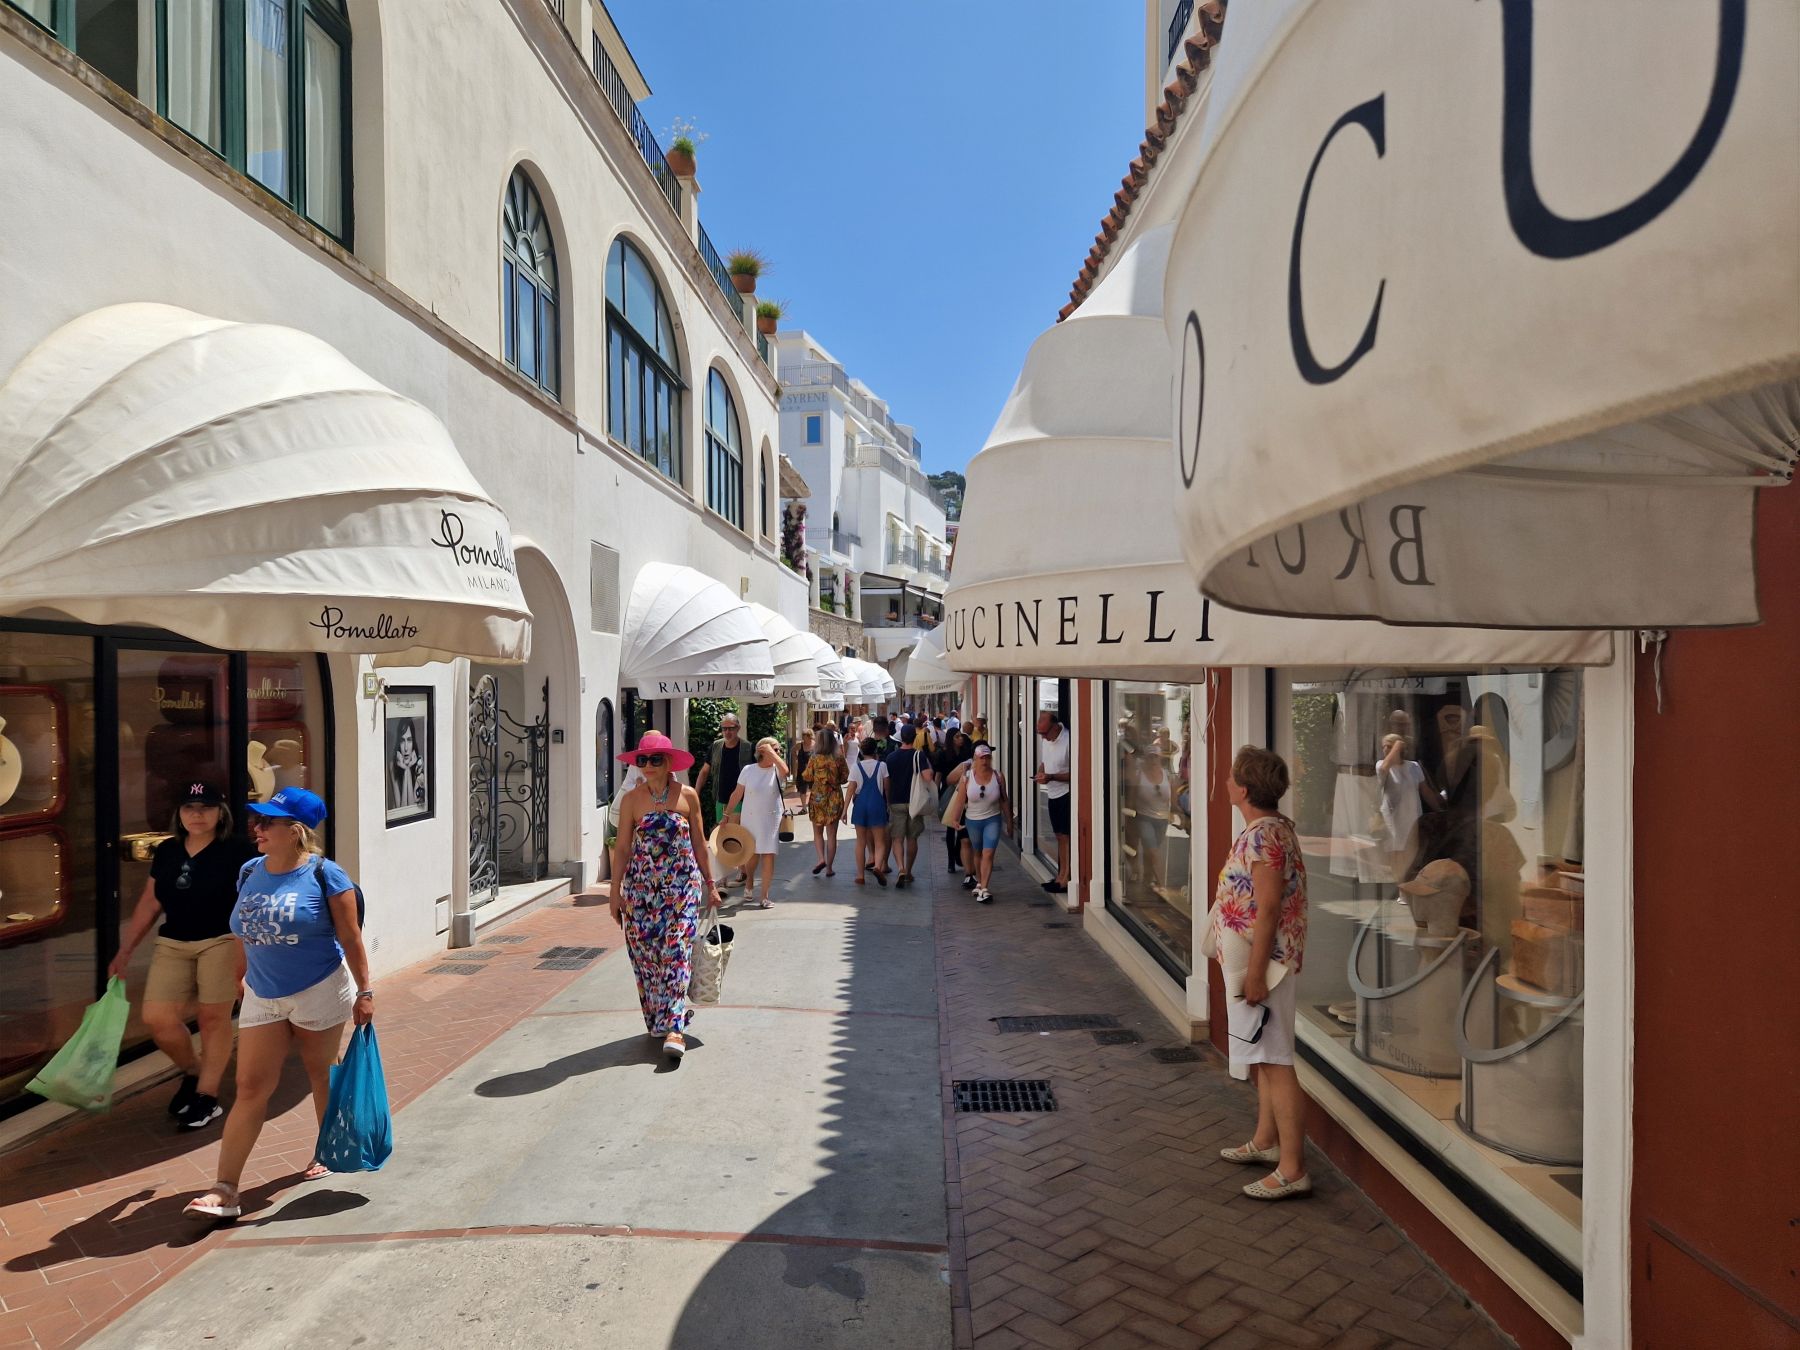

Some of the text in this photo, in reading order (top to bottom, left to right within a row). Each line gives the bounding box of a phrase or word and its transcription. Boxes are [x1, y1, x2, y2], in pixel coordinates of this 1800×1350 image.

[308, 605, 420, 640] Pomellato
[945, 590, 1215, 654] CUCINELLI
[658, 679, 716, 693] RALPH
